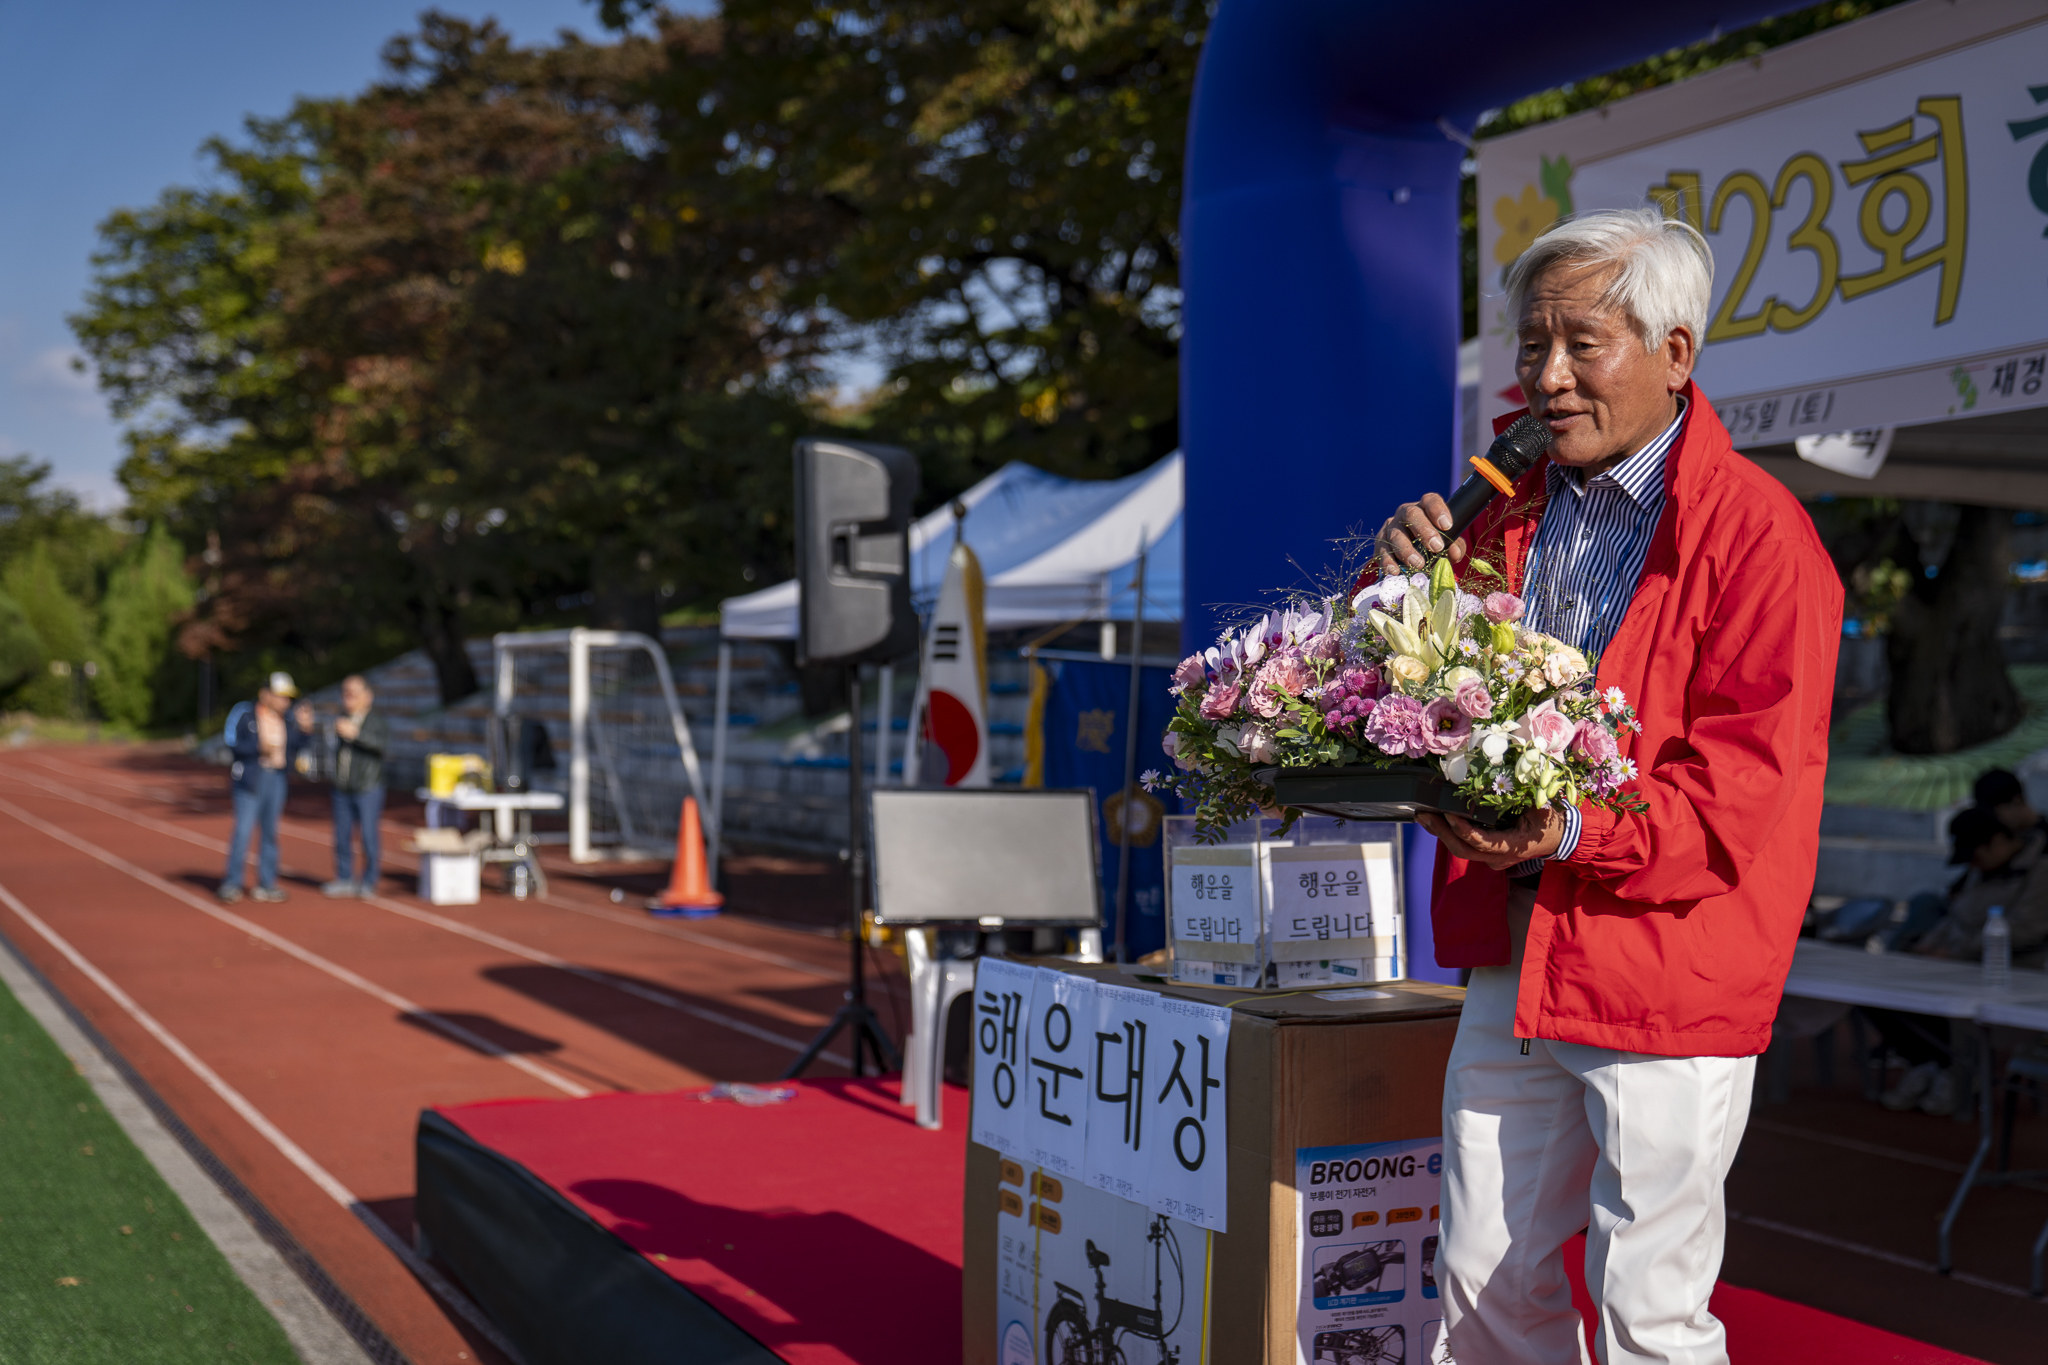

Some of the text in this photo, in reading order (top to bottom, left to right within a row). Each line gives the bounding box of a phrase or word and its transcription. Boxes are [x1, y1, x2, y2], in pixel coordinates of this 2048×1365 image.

[1988, 352, 2047, 398] 재경
[1717, 396, 1783, 435] 25일
[1191, 874, 1233, 901] 행운을
[1299, 870, 1362, 899] 행운을
[1185, 916, 1242, 943] 드립니다
[1289, 912, 1374, 941] 드립니다
[977, 990, 1220, 1172] 행운대상
[1335, 1188, 1351, 1200] 전기
[1353, 1187, 1377, 1198] 자전거
